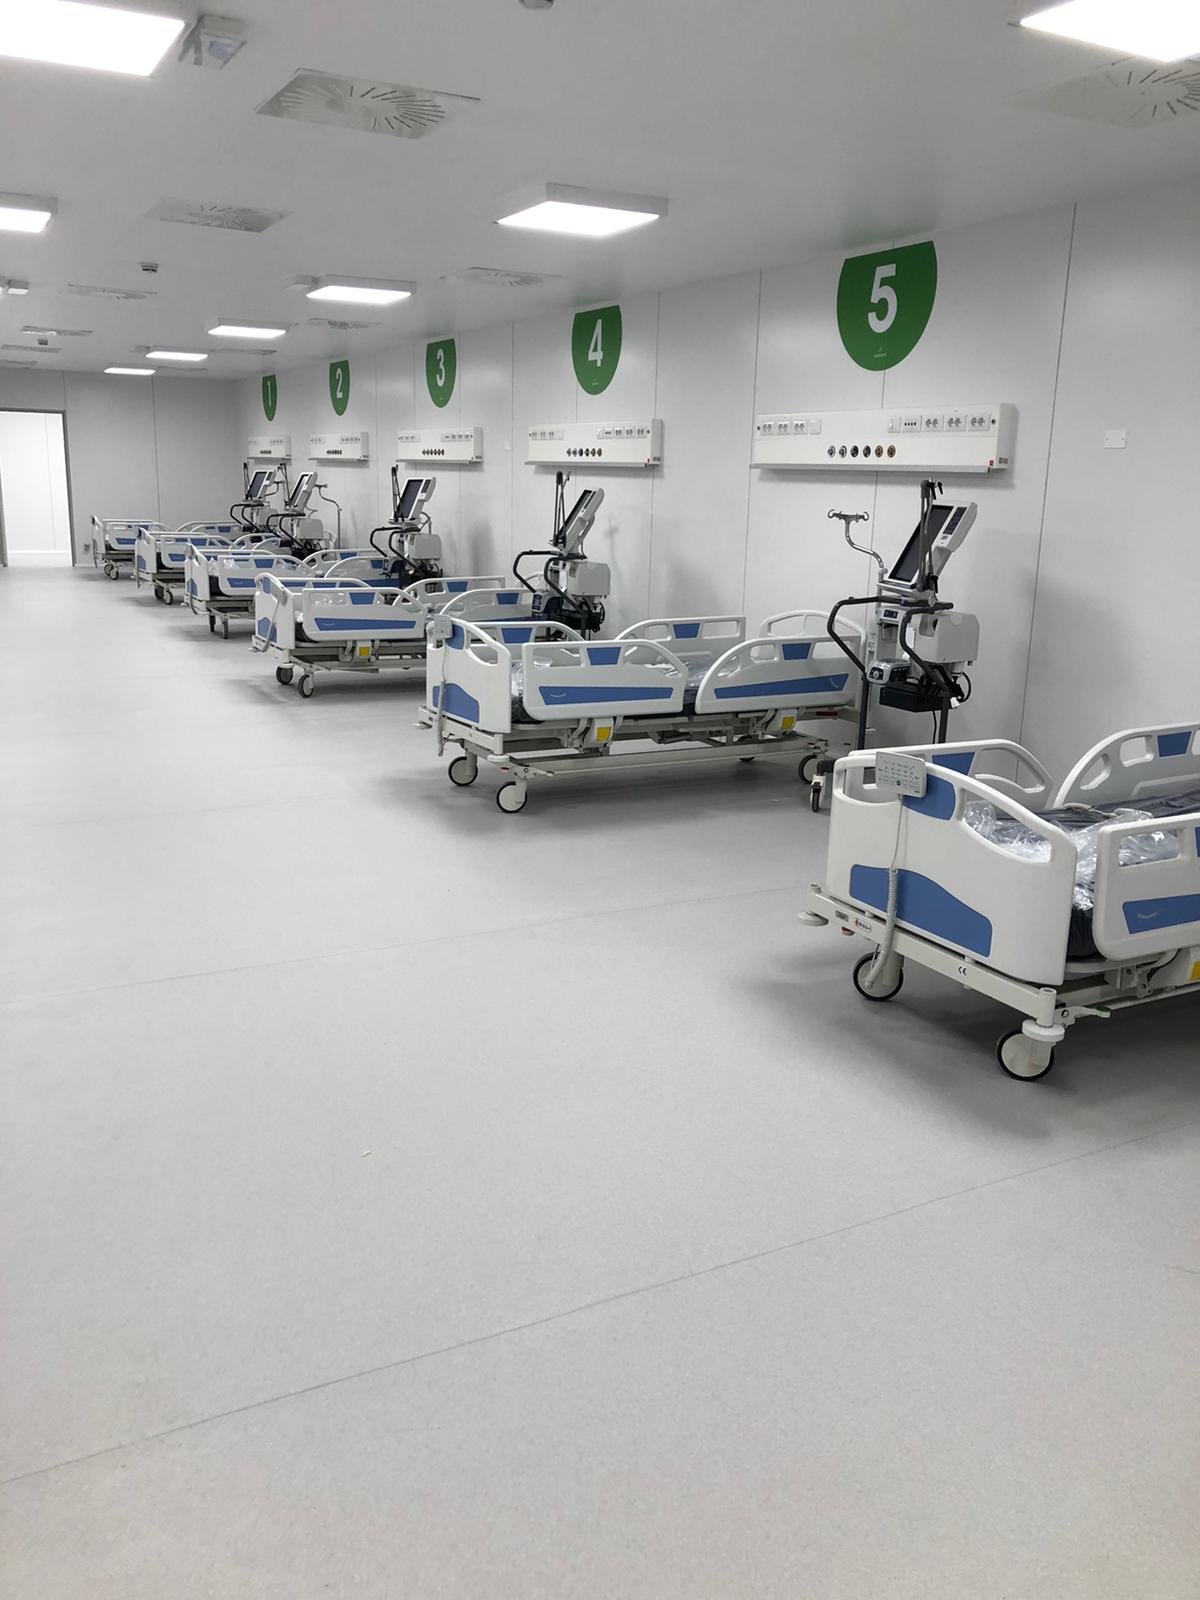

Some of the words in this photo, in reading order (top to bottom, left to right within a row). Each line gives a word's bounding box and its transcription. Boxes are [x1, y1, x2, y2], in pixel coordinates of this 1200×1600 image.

[868, 264, 898, 334] 5
[588, 318, 604, 367] 4
[335, 368, 343, 399] 2
[436, 348, 446, 387] 3
[267, 379, 272, 407] 1
[958, 966, 968, 976] CE
